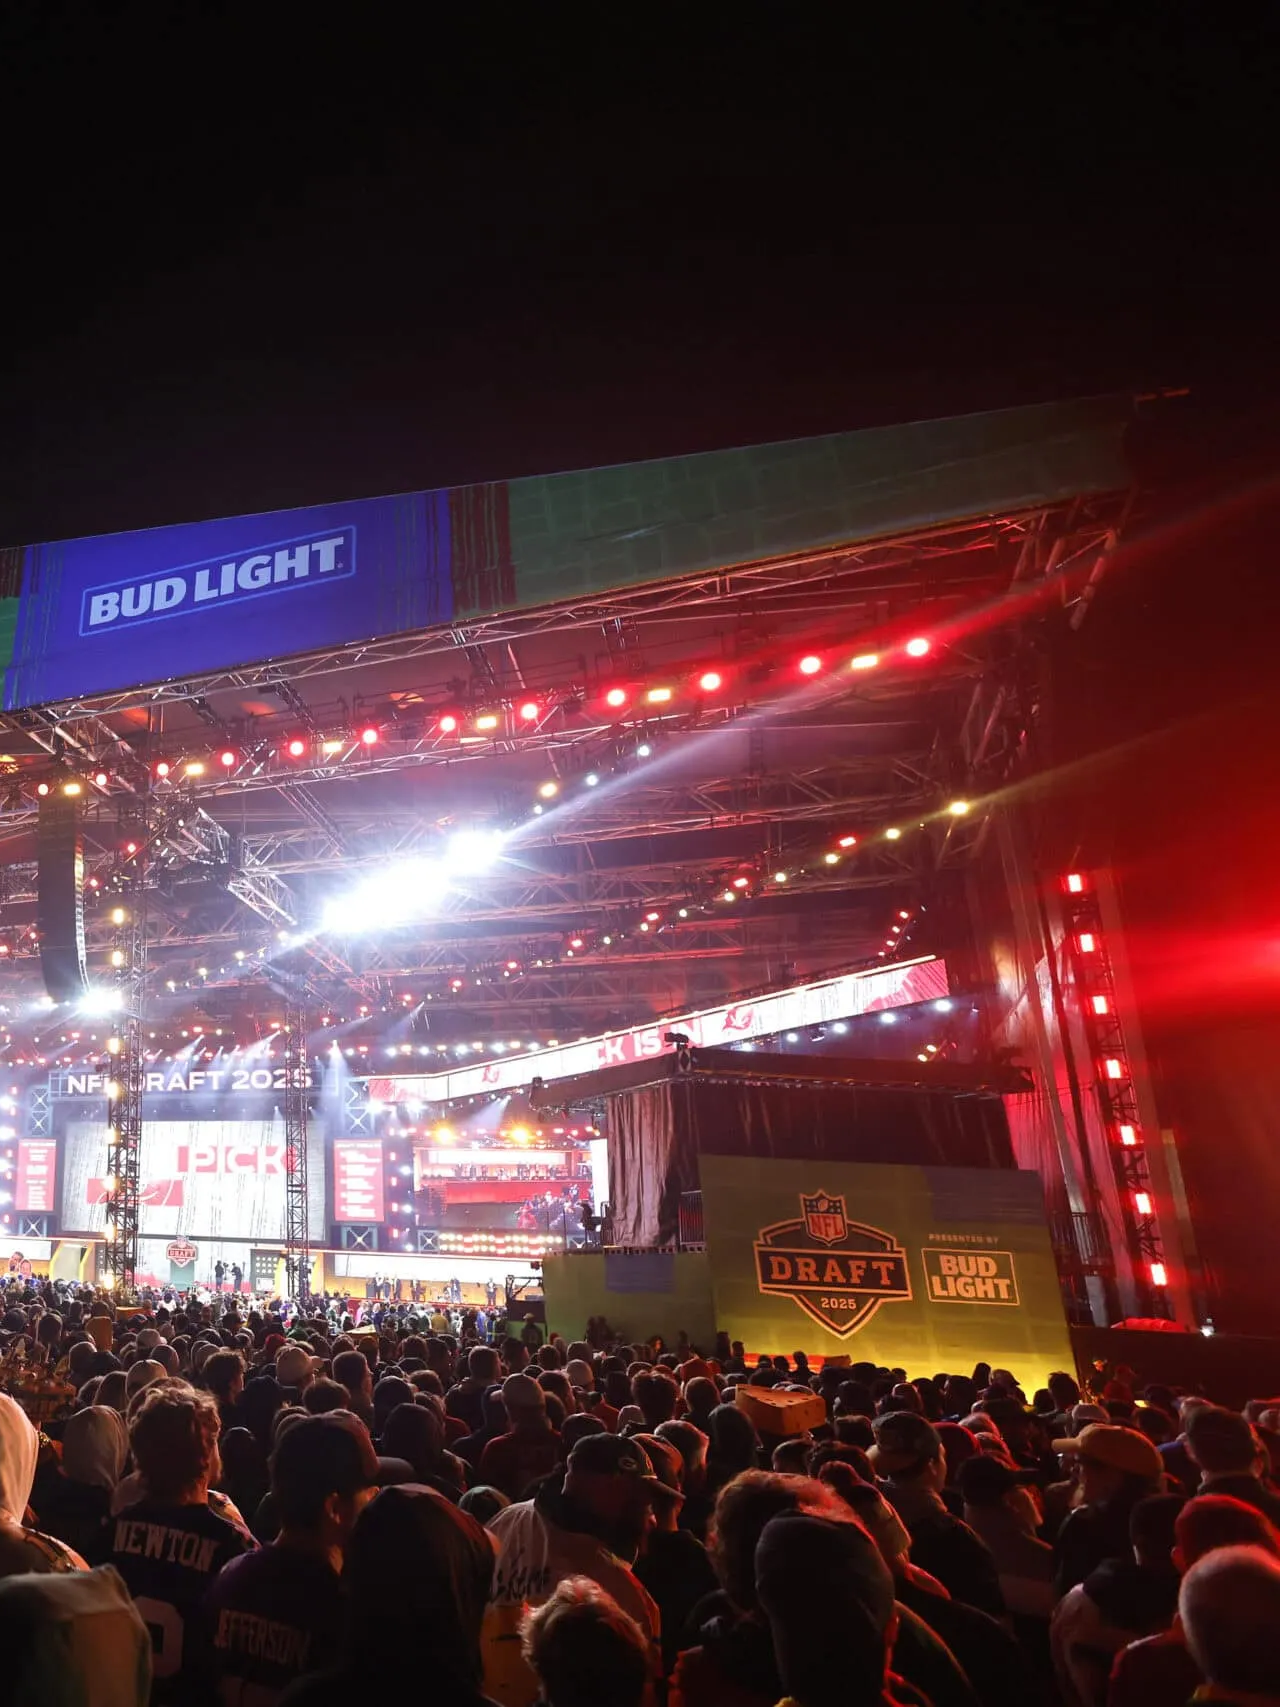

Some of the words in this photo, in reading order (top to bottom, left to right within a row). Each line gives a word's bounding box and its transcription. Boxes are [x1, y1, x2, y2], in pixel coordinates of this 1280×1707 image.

[89, 577, 187, 626] BUD
[194, 536, 344, 602] LIGHT
[633, 1027, 662, 1057] IS
[232, 1069, 313, 1090] 2025
[188, 1145, 286, 1174] PICK
[810, 1214, 844, 1237] NFL
[928, 1233, 983, 1243] PRESENTED
[986, 1236, 999, 1244] BY
[770, 1256, 895, 1286] DRAFT
[940, 1254, 998, 1277] BUD
[931, 1275, 1010, 1299] LIGHT
[821, 1298, 857, 1310] 2025
[112, 1519, 220, 1573] NEWTON
